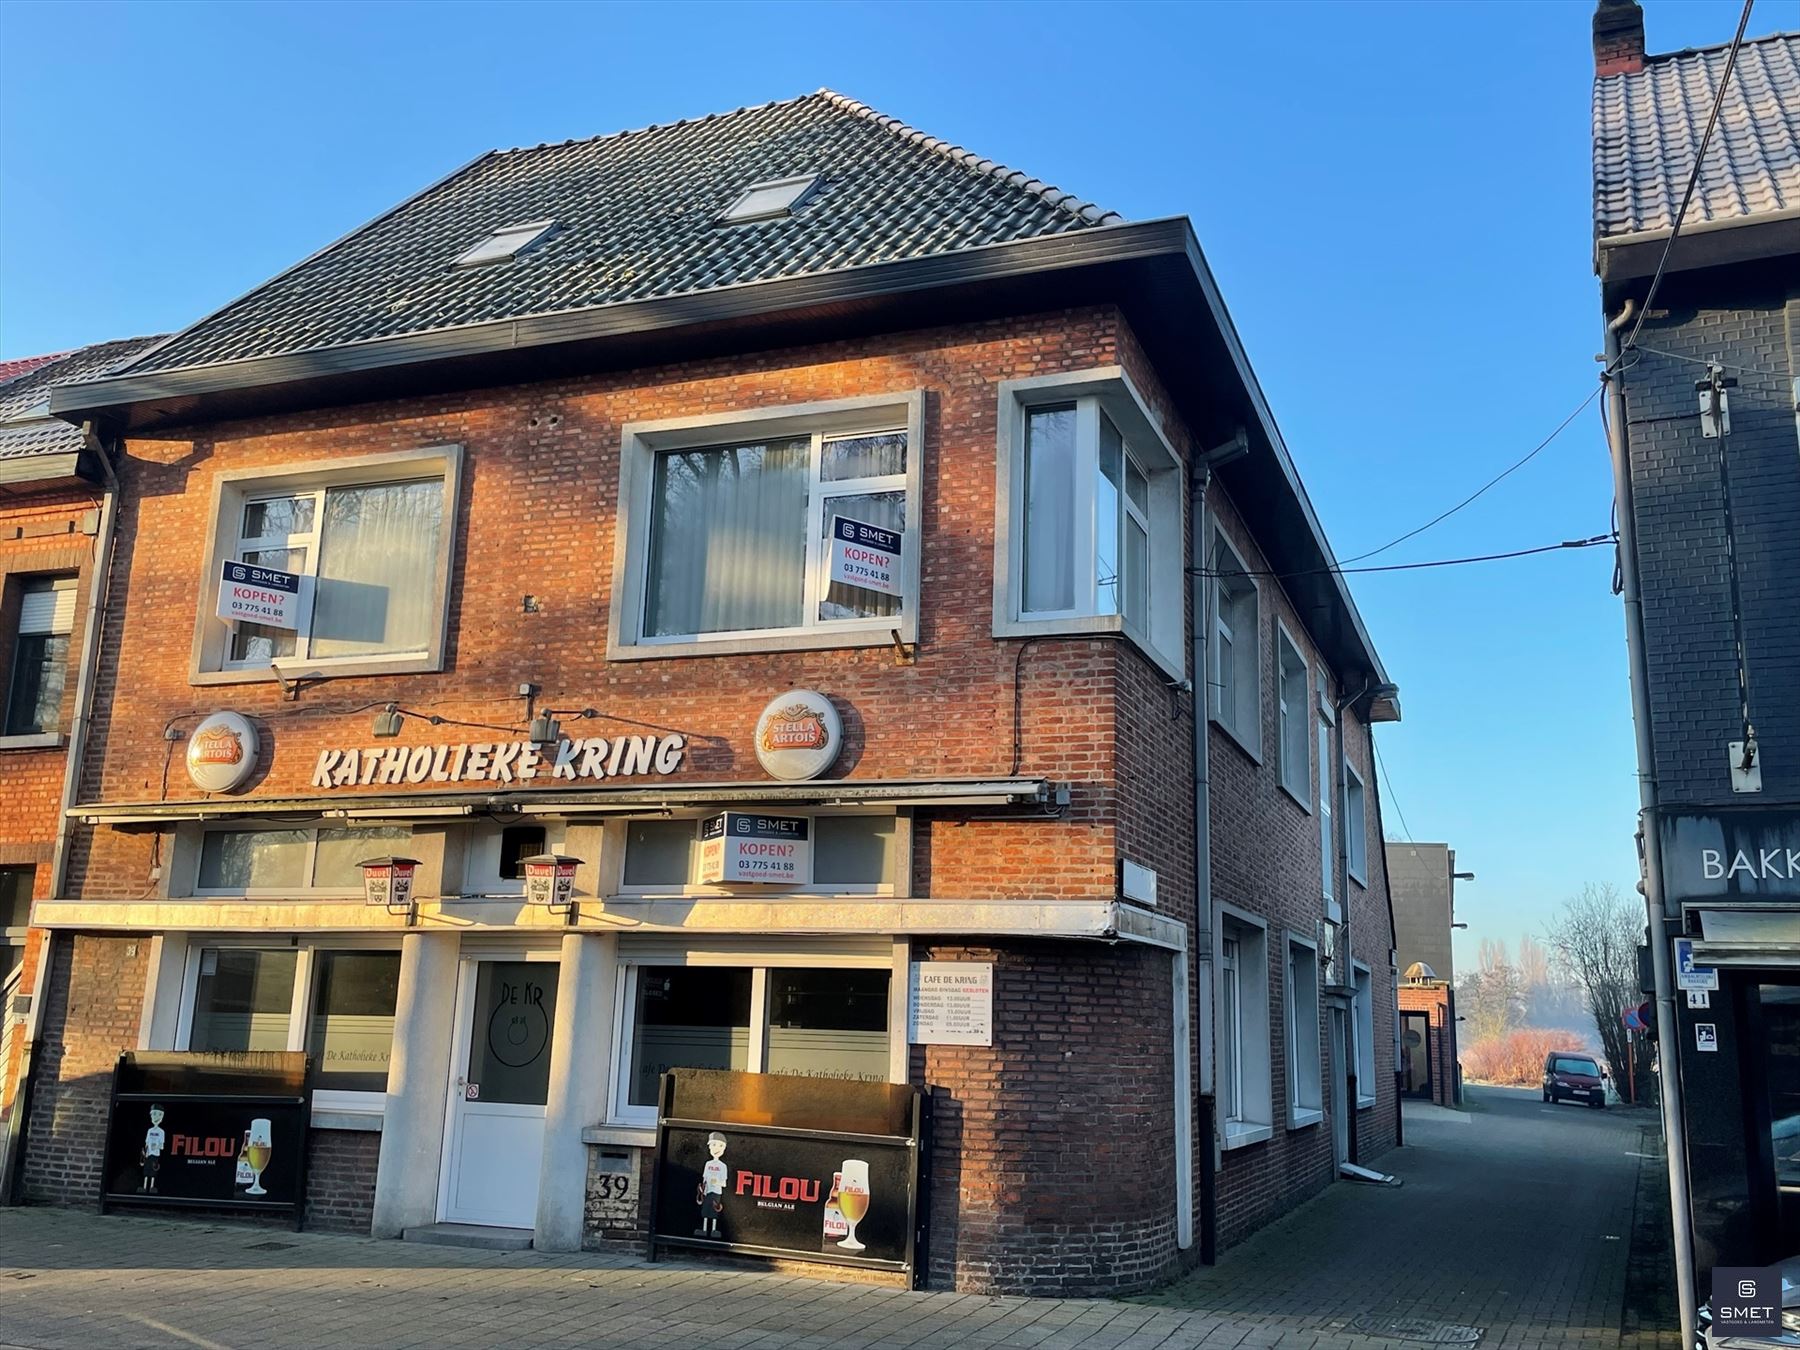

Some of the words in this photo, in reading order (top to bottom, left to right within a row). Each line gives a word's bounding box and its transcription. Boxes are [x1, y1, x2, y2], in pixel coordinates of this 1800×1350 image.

[860, 527, 894, 544] SMET
[844, 547, 890, 568] KOPEN?
[251, 569, 291, 585] SMET
[844, 563, 853, 573] 03
[855, 566, 869, 577] 775
[870, 570, 879, 580] 41
[880, 572, 890, 582] 88
[233, 587, 285, 605] KOPEN?
[232, 601, 243, 610] 03
[245, 603, 260, 612] 775
[261, 607, 271, 615] 41
[273, 609, 284, 617] 88
[773, 722, 816, 733] STELLA
[202, 740, 233, 749] TELLA
[772, 733, 816, 743] ARTOIS
[311, 742, 543, 790] KATHOLIEKE
[552, 734, 685, 782] KRING
[757, 819, 799, 831] SMET
[739, 842, 794, 857] KOPEN?
[739, 860, 750, 868] 03
[752, 861, 768, 870] 775
[770, 862, 781, 870] 41
[783, 862, 794, 871] 88
[1702, 848, 1800, 879] BAKK
[366, 866, 389, 878] Duvel
[394, 866, 413, 878] Duvel
[528, 864, 553, 877] Duvel
[557, 865, 575, 877] Duvel
[738, 870, 794, 879] vastgoed-smet.be
[923, 975, 942, 984] CAFE
[943, 976, 953, 984] DE
[954, 976, 978, 985] KRING
[501, 982, 518, 1005] DE
[524, 982, 543, 1005] KR
[1690, 993, 1706, 1005] 41
[326, 1050, 337, 1061] De
[170, 1133, 236, 1157] FILOU
[598, 1174, 629, 1200] 39
[734, 1169, 821, 1203] FILOU
[757, 1201, 783, 1209] BELGIAN
